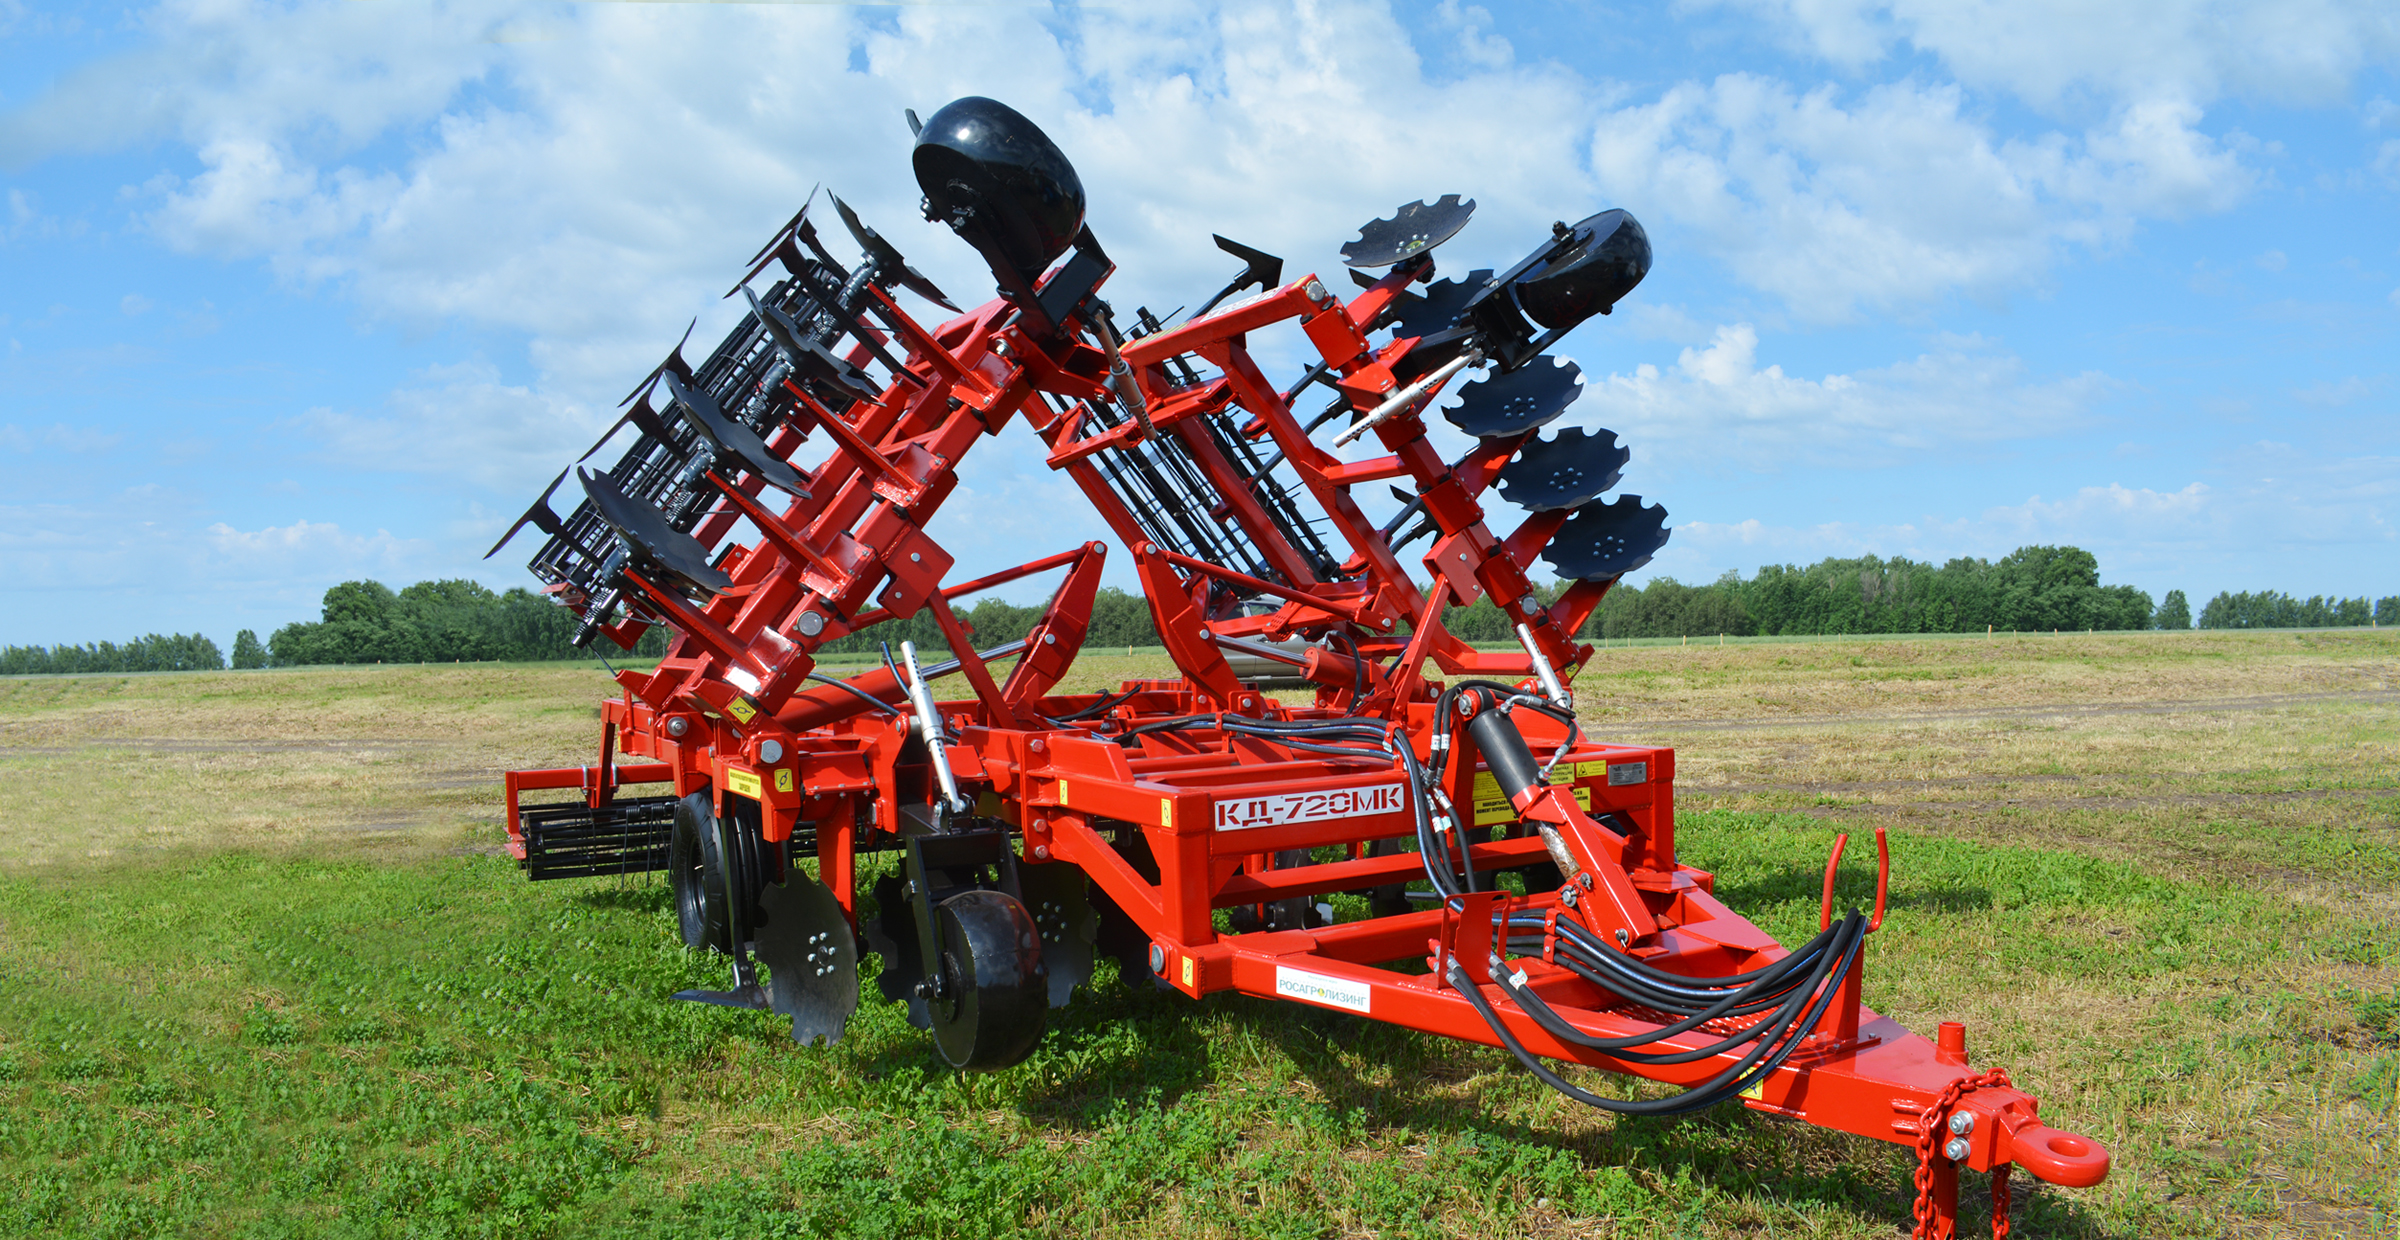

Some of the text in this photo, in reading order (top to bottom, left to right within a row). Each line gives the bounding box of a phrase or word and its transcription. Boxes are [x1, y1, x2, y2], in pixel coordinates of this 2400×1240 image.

[1218, 787, 1401, 827] КД-720МК
[1279, 979, 1367, 1006] РОСАГРОЛИЗИНГ
[1775, 1030, 1808, 1065] POWERMASTER
